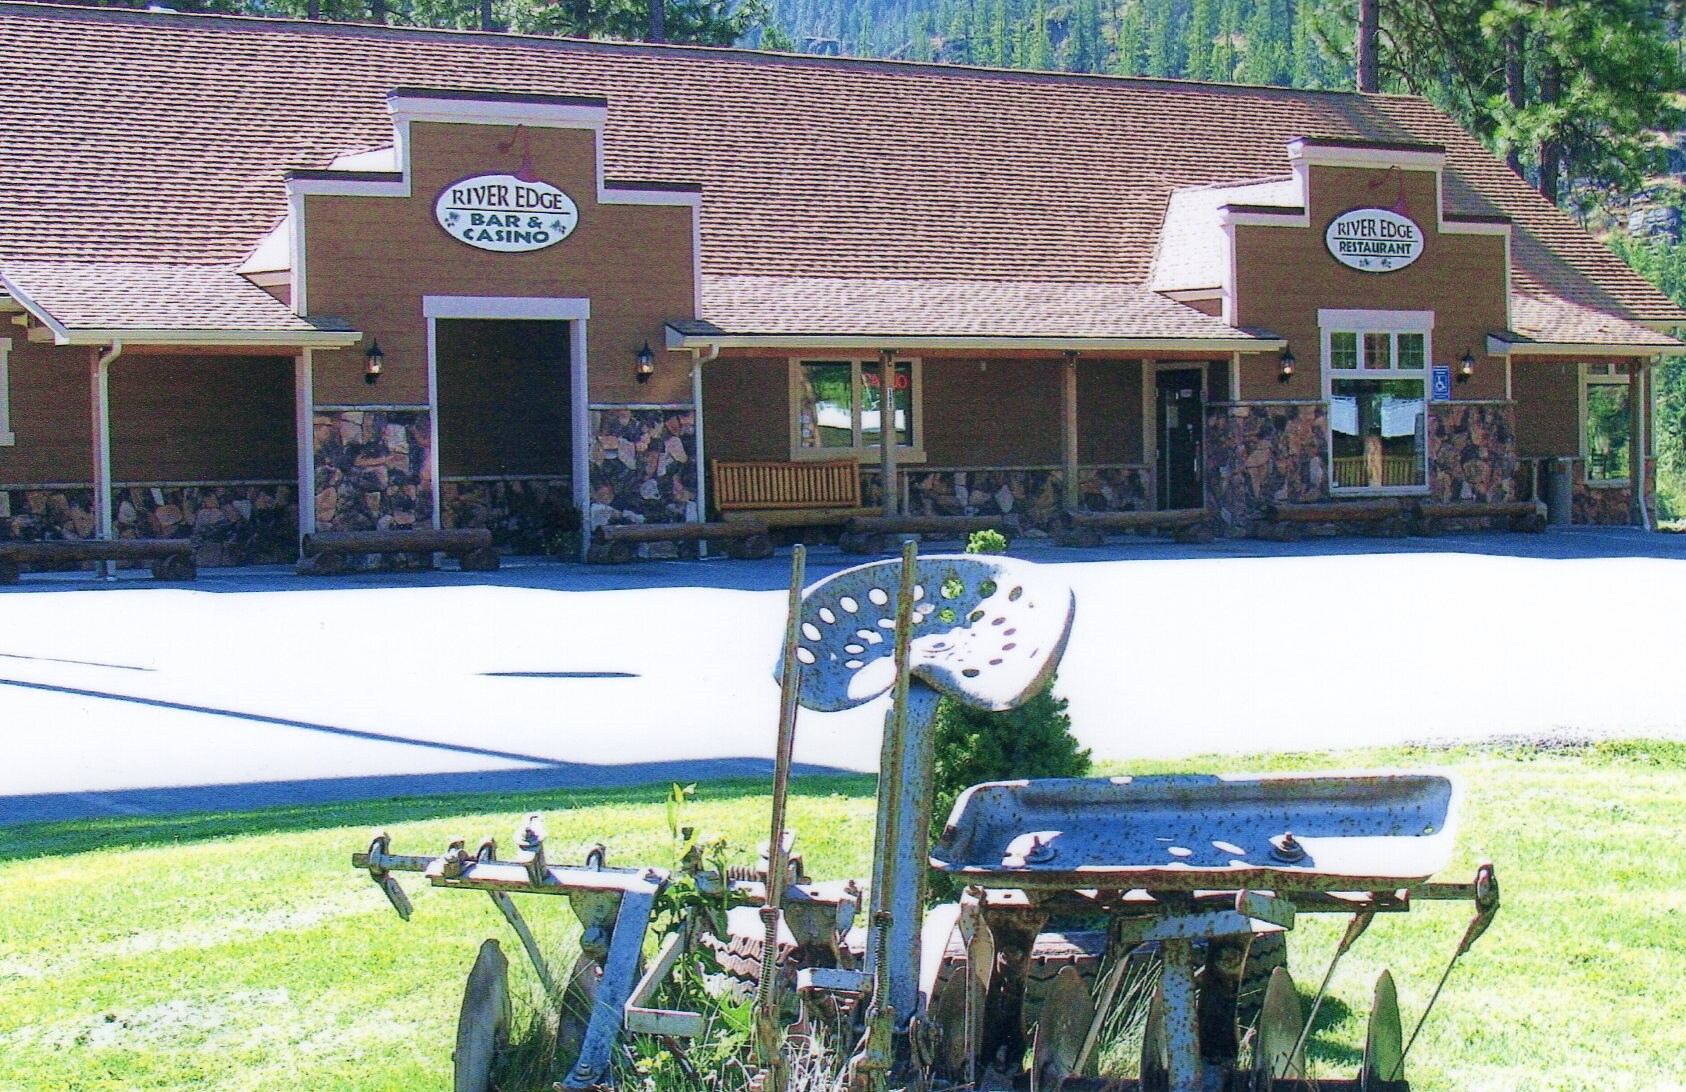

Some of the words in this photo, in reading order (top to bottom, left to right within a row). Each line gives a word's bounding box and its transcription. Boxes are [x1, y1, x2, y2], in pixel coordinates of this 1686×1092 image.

[452, 185, 510, 208] RIVER
[515, 186, 562, 210] EDGE
[470, 213, 521, 228] BAR
[527, 216, 544, 229] &
[1337, 219, 1377, 237] RIVER
[1380, 219, 1413, 239] EDGE
[463, 228, 550, 244] CASINO
[1339, 241, 1412, 255] RESTAURANT
